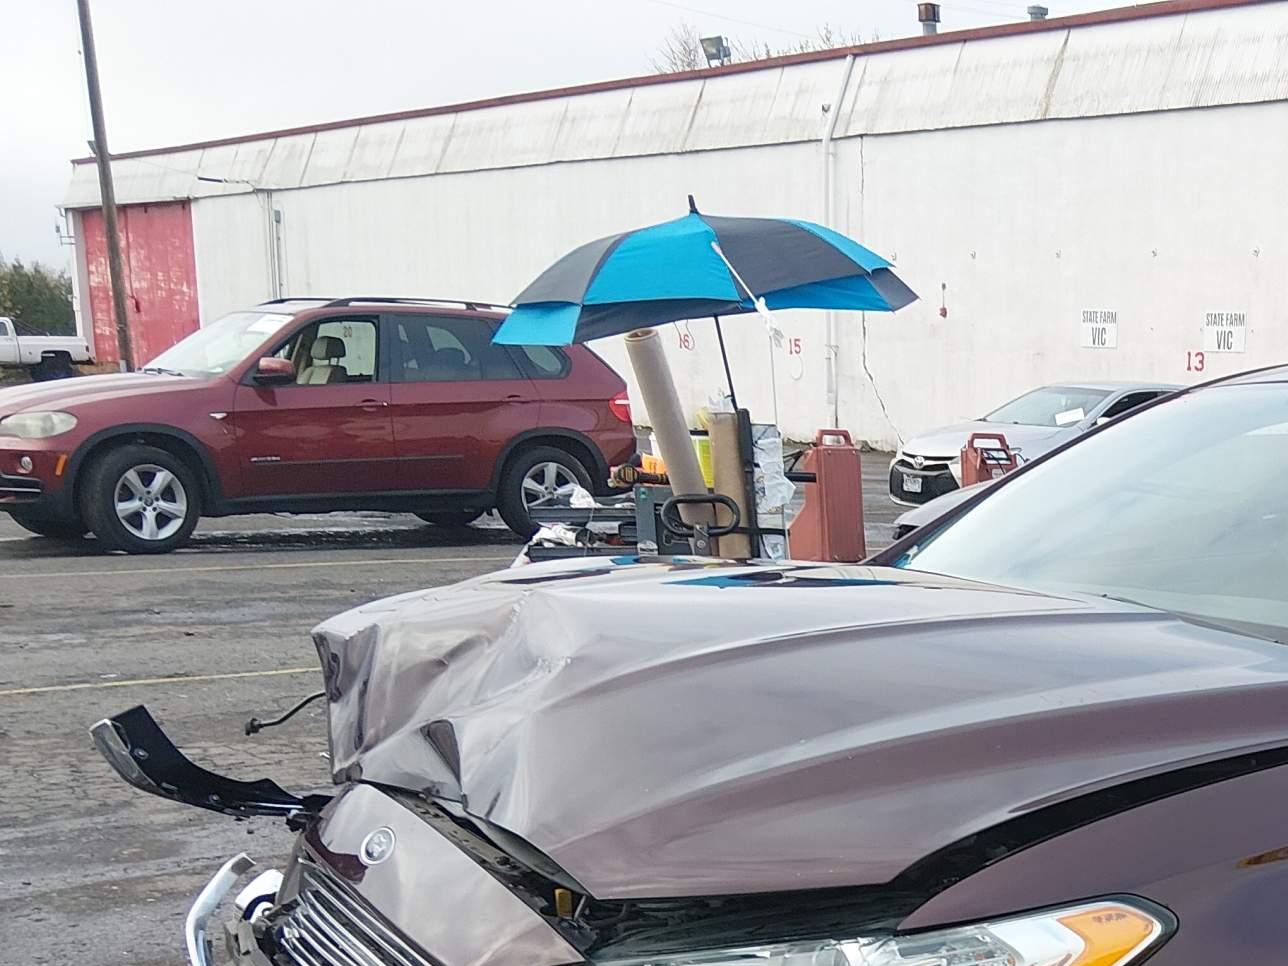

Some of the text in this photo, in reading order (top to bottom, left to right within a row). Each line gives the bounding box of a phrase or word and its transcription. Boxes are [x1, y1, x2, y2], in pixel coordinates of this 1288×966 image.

[1082, 310, 1117, 324] STATE FARM
[1205, 312, 1245, 327] STATE FARM
[1091, 327, 1107, 346] VIC
[1216, 330, 1233, 350] VIC
[788, 338, 801, 355] 15
[1186, 351, 1205, 372] 13
